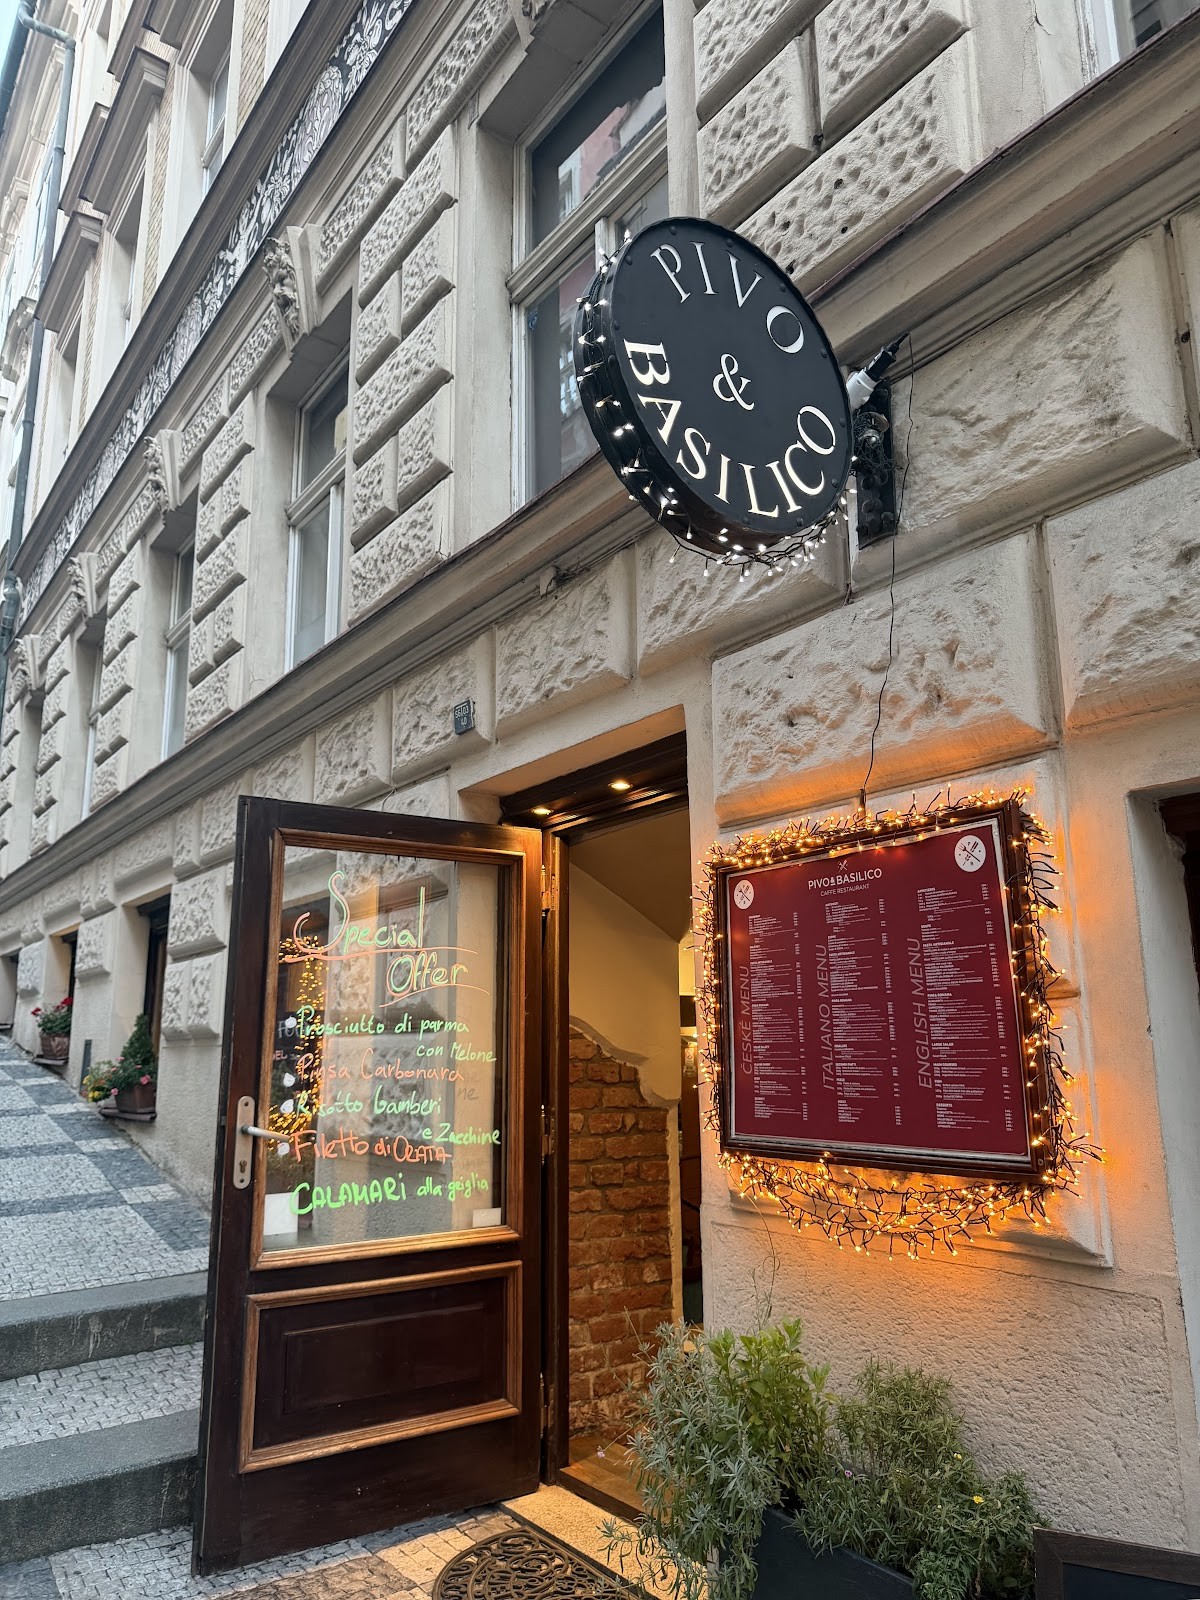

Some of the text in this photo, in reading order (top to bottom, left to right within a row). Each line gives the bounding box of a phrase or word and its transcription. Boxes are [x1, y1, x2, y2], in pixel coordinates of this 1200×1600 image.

[650, 241, 805, 354] PIVO
[712, 353, 755, 411] &
[623, 338, 836, 518] BASILICO
[293, 870, 426, 955] Special
[836, 883, 870, 894] RESTAURANT
[386, 950, 469, 998] Offer
[739, 965, 751, 1016] MENU
[296, 1004, 385, 1037] Prosciutto
[394, 1012, 412, 1034] di
[419, 1018, 470, 1041] parma
[815, 944, 835, 1090] ITALIANO MENU
[906, 937, 933, 1089] ENGLISH MENU
[360, 1048, 465, 1082] Carbonara
[416, 1042, 497, 1063] con Melone
[290, 1126, 370, 1163] Filetto
[374, 1136, 391, 1157] di
[422, 1127, 433, 1140] e
[416, 1176, 443, 1197] alla
